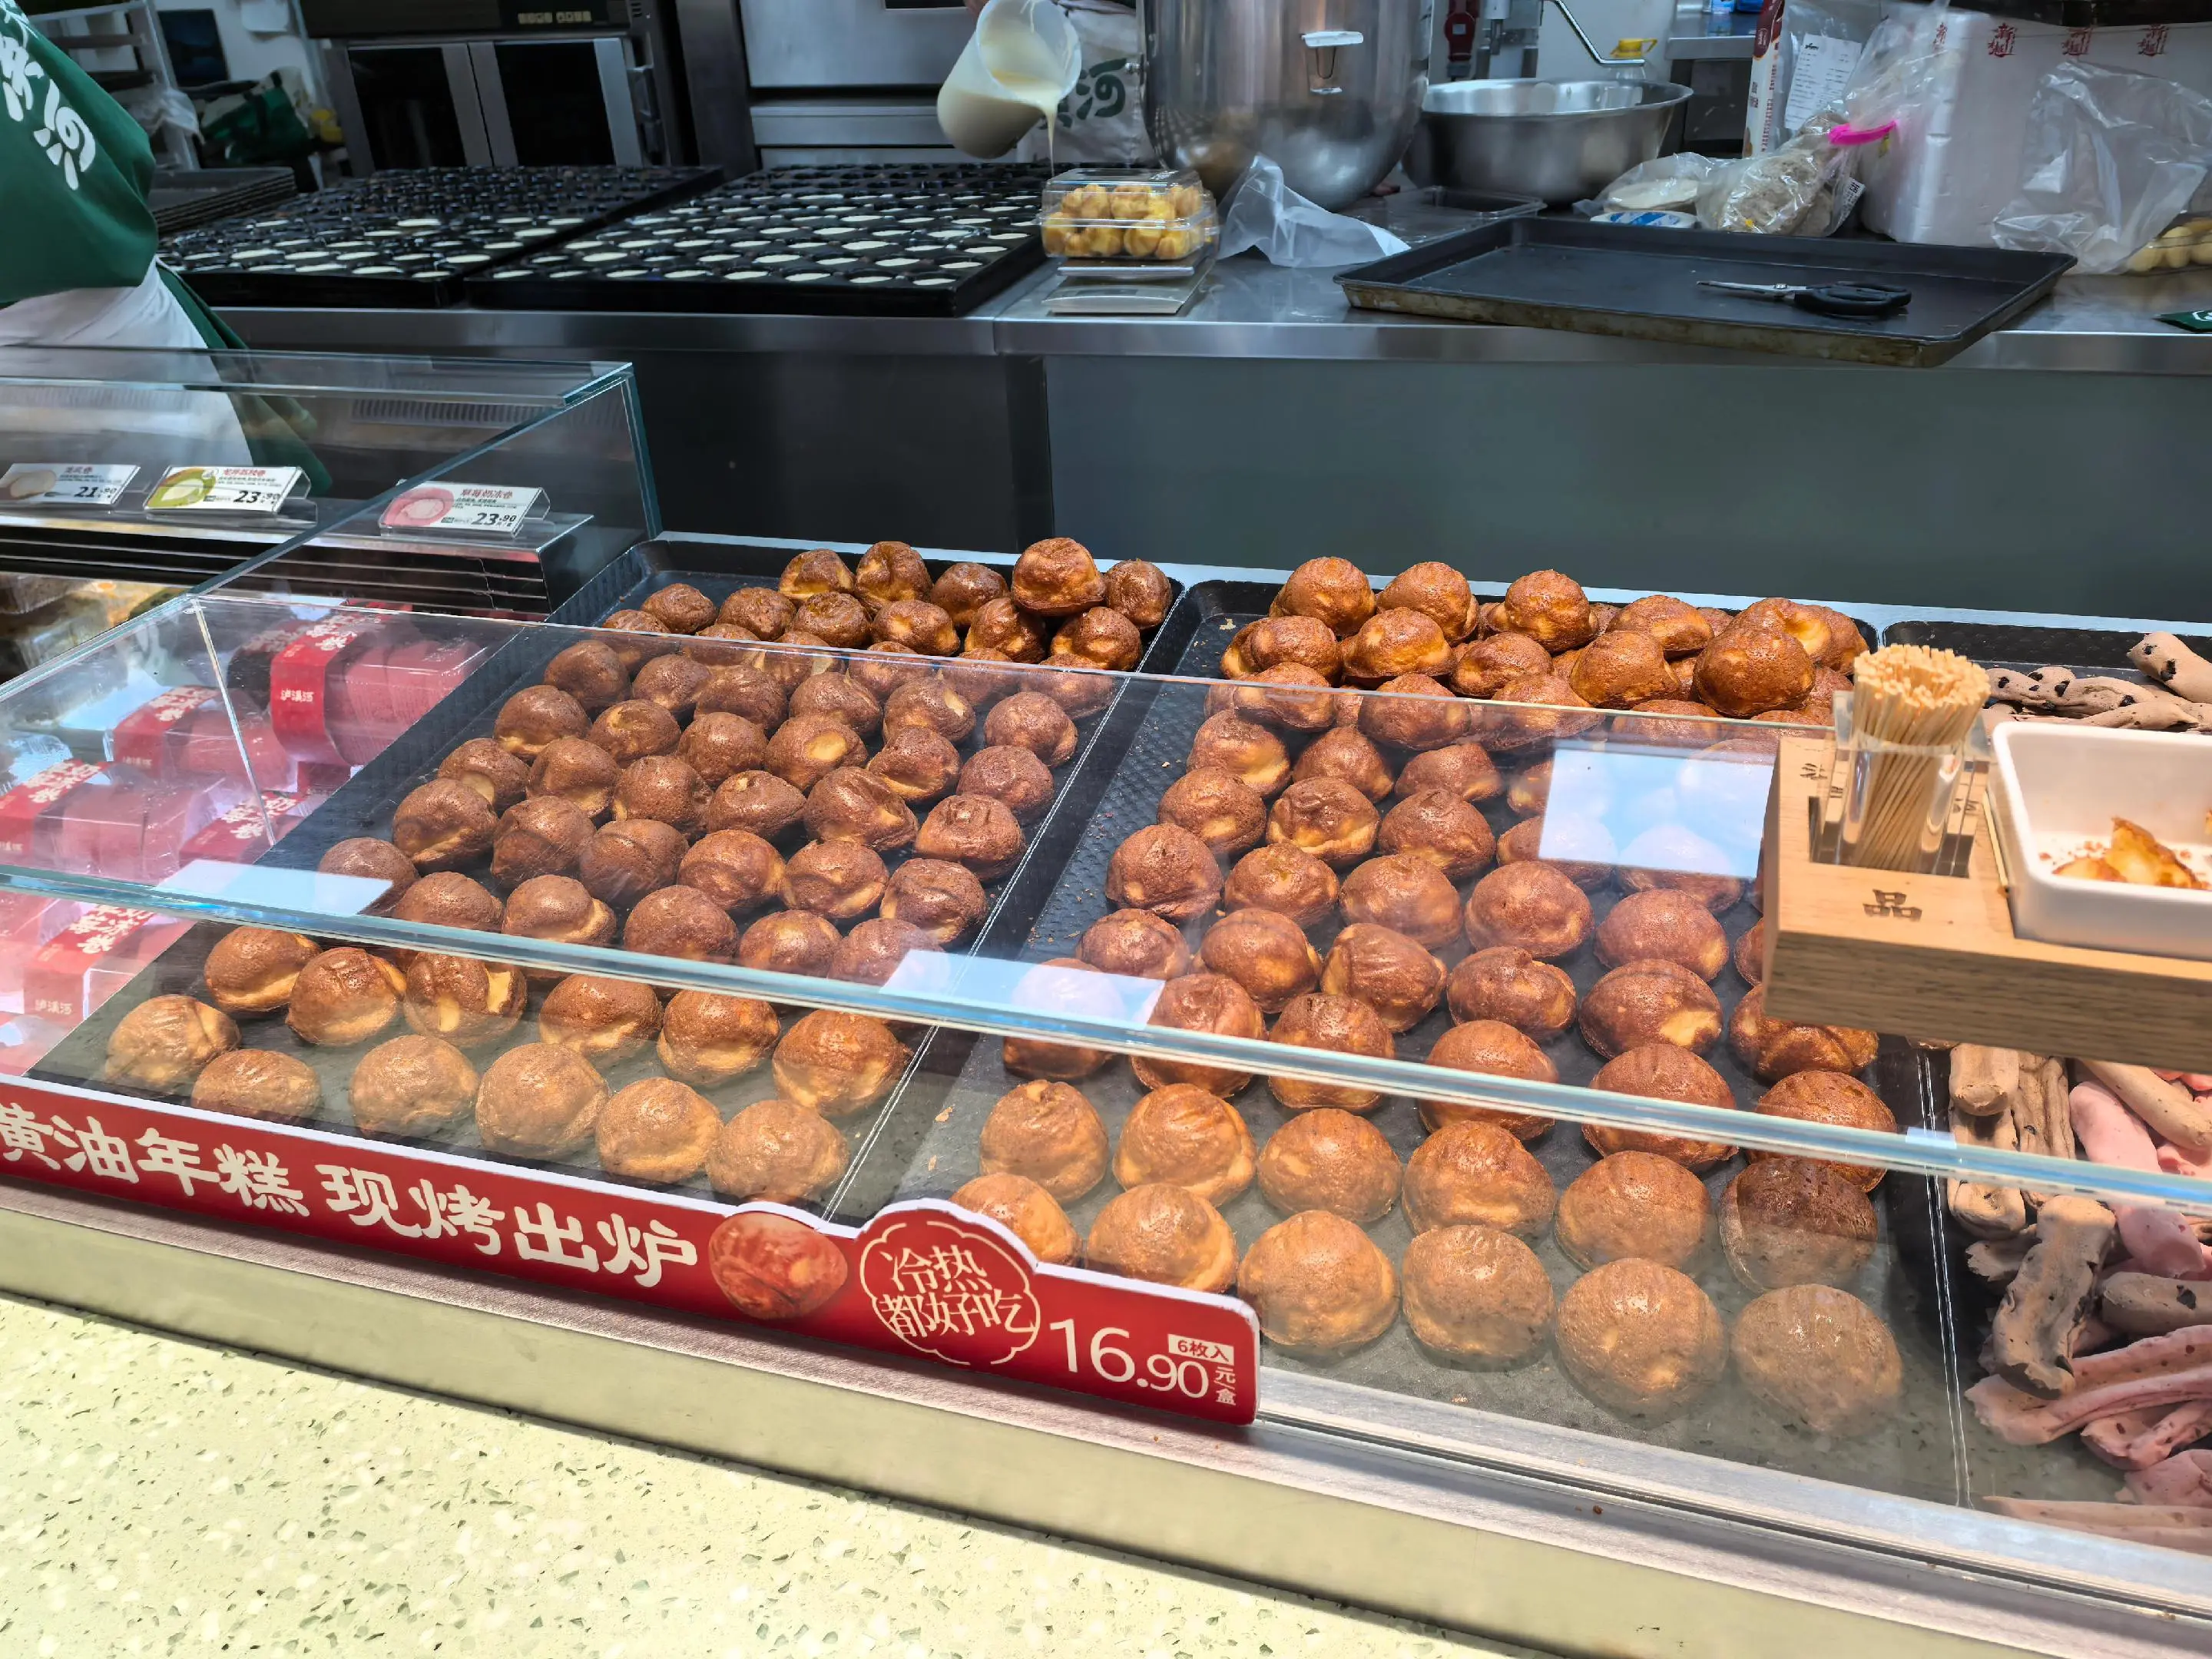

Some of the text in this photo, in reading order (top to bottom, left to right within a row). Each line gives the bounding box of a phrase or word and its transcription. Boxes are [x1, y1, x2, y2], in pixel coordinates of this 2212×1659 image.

[471, 512, 517, 525] 23.90
[1863, 889, 1922, 922] 品
[0, 1102, 697, 1287] 黄油年糕 现烤出炉
[880, 1244, 993, 1293] 冷热
[880, 1288, 1037, 1338] 都好吃
[1050, 1318, 1210, 1399] 16.90
[1177, 1339, 1230, 1363] 6枚入
[1214, 1366, 1237, 1406] 元/盒
